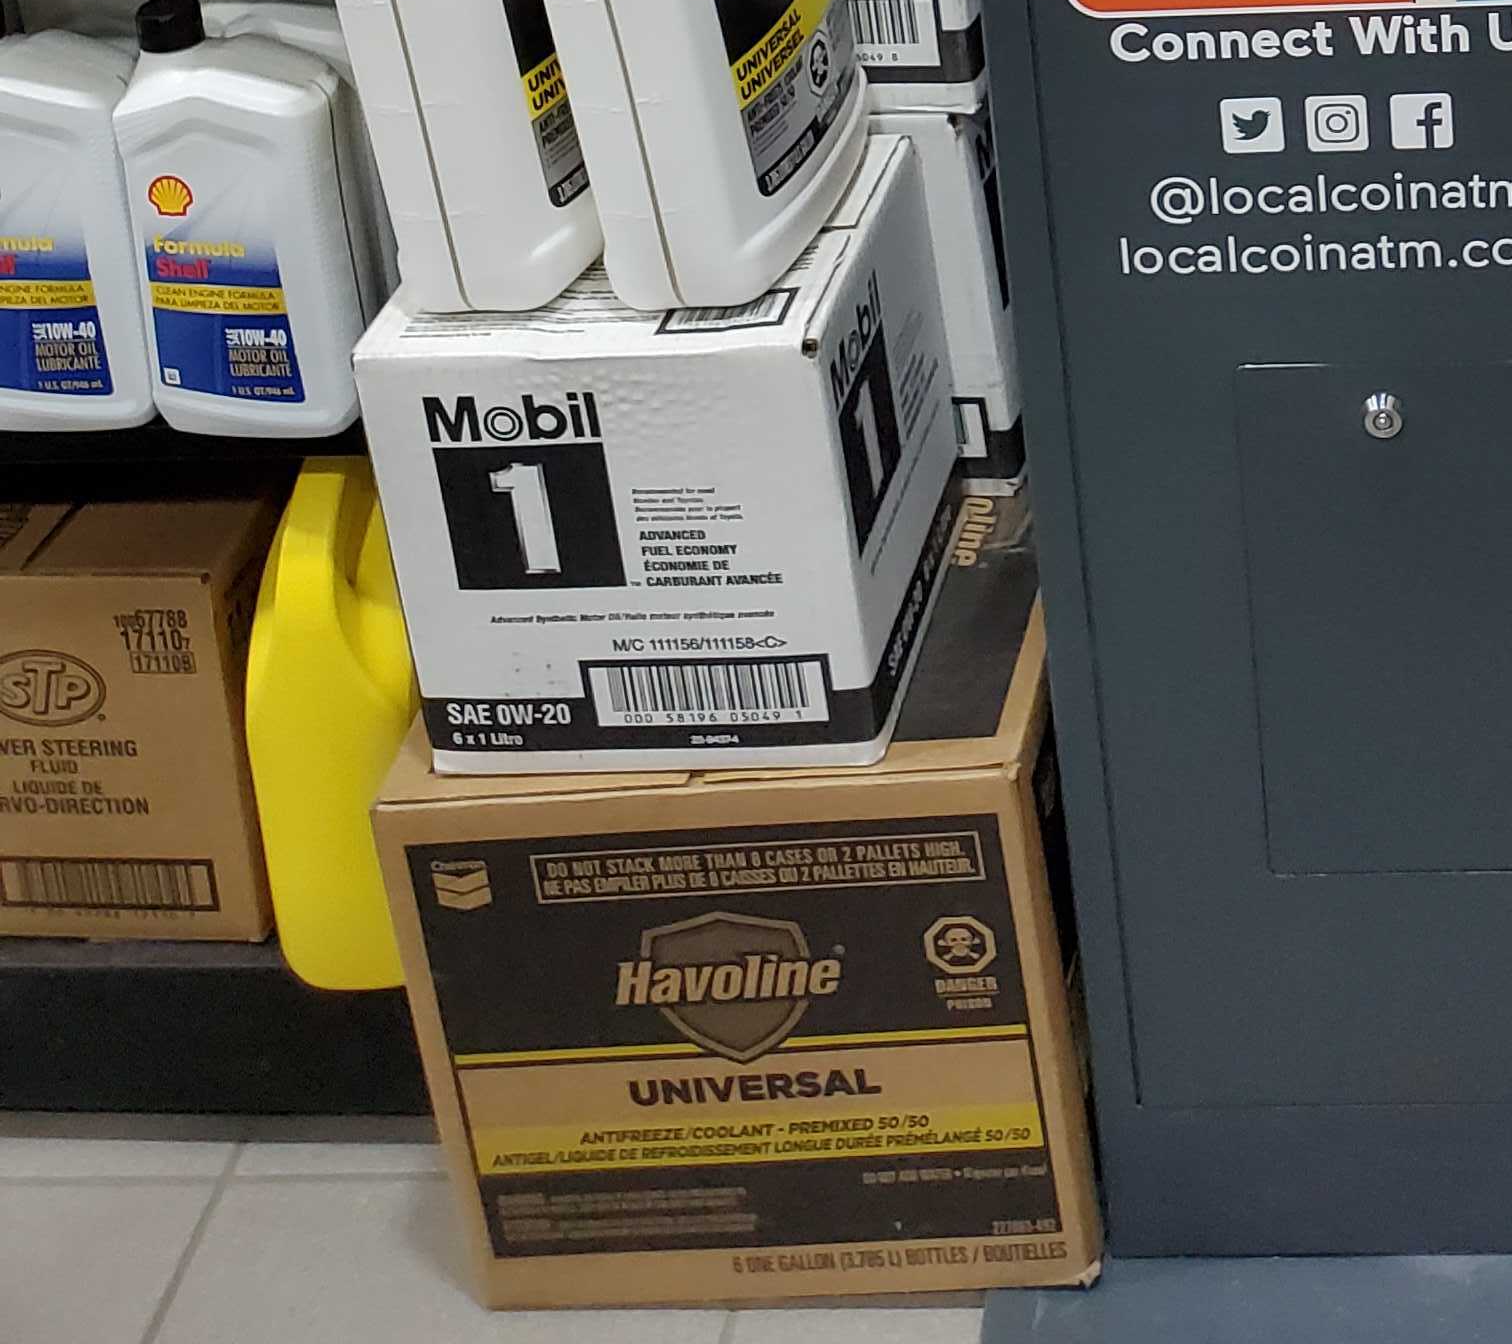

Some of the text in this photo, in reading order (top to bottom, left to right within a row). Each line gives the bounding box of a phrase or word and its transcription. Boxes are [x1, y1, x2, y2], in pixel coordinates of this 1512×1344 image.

[736, 9, 801, 81] UNIVERSAL
[1110, 22, 1332, 63] Connect
[1349, 15, 1470, 55] With
[741, 31, 805, 100] UNIVERSEL
[422, 392, 601, 442] Mobil
[489, 463, 561, 574] 1
[447, 703, 571, 725] SAE 0W-20
[616, 954, 841, 1006] Havoline
[629, 1069, 881, 1106] UNIVERSAL
